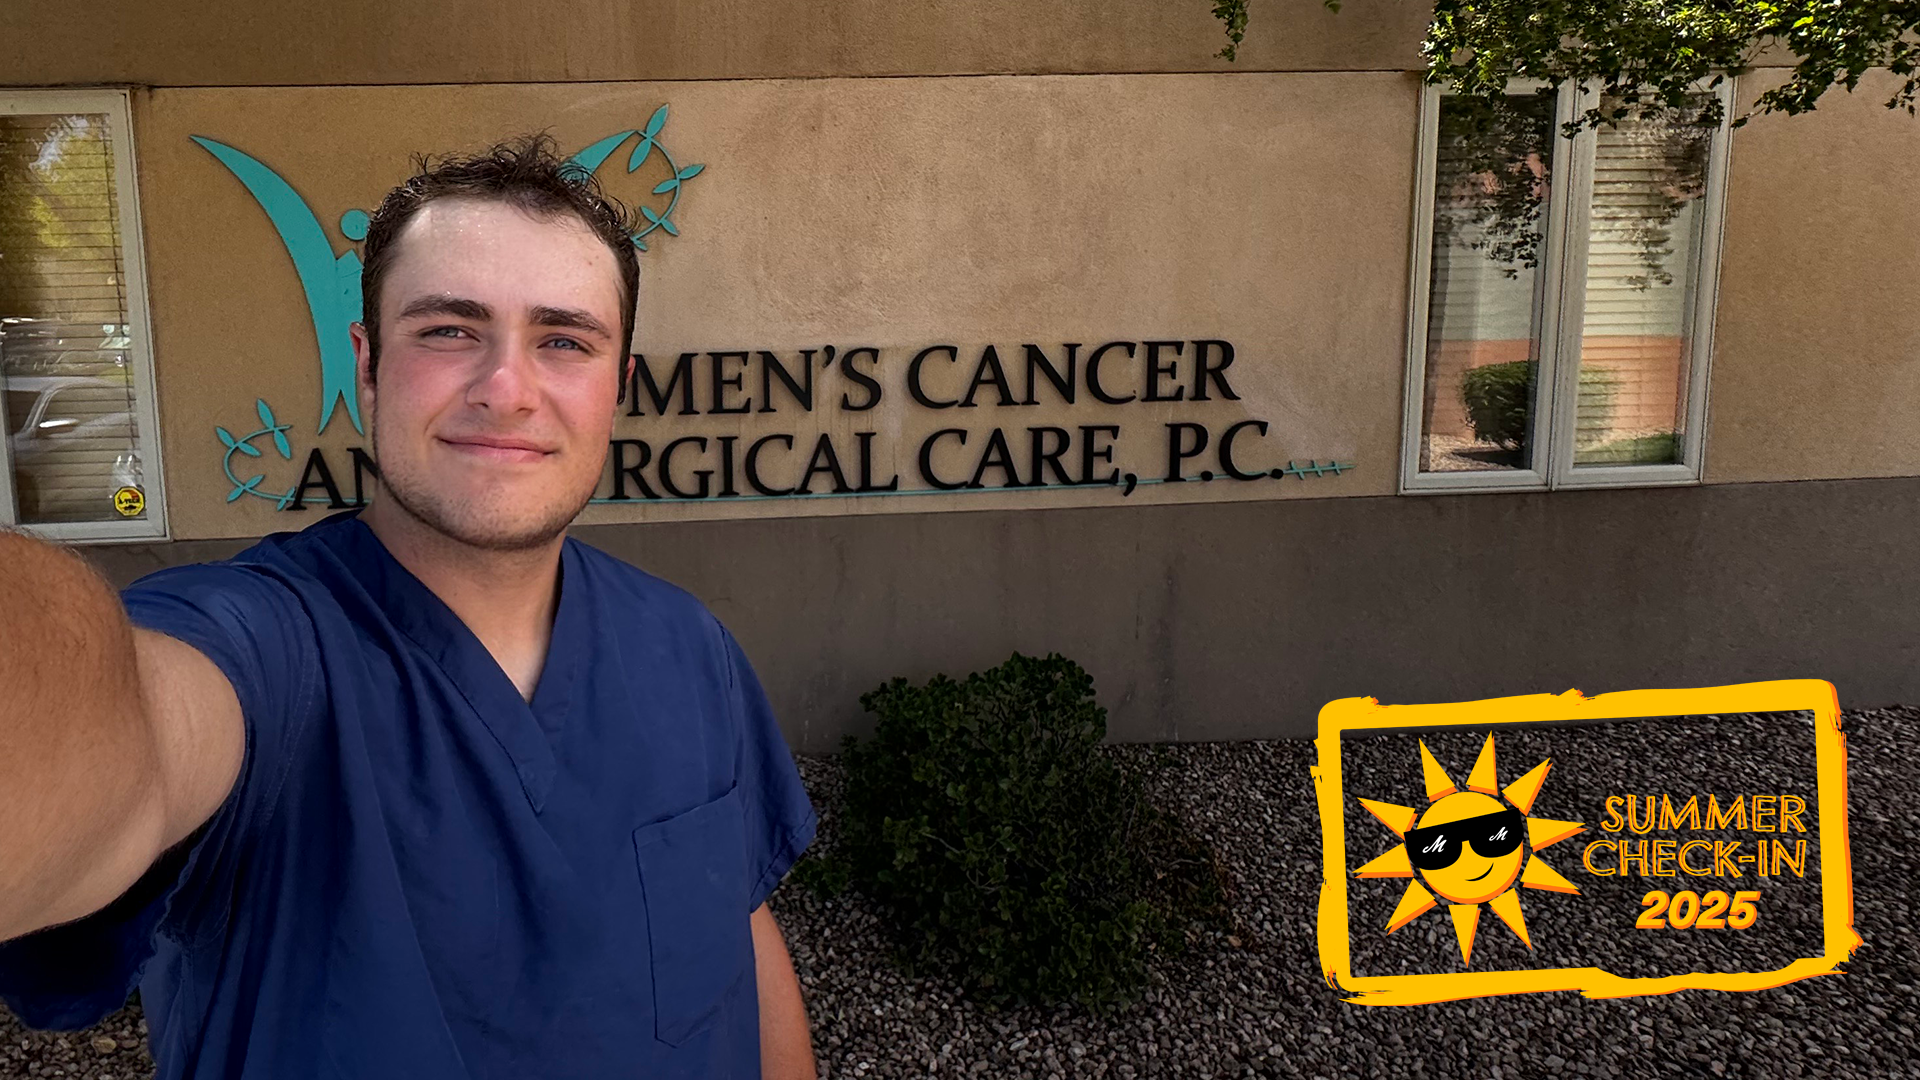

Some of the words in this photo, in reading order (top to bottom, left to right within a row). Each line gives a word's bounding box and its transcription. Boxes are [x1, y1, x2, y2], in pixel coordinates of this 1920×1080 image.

[626, 344, 882, 417] MEN'S
[906, 339, 1242, 410] CANCER
[285, 447, 383, 511] AN
[609, 431, 899, 501] RGICAL
[918, 425, 1138, 498] CARE,
[1162, 419, 1285, 483] P.C.
